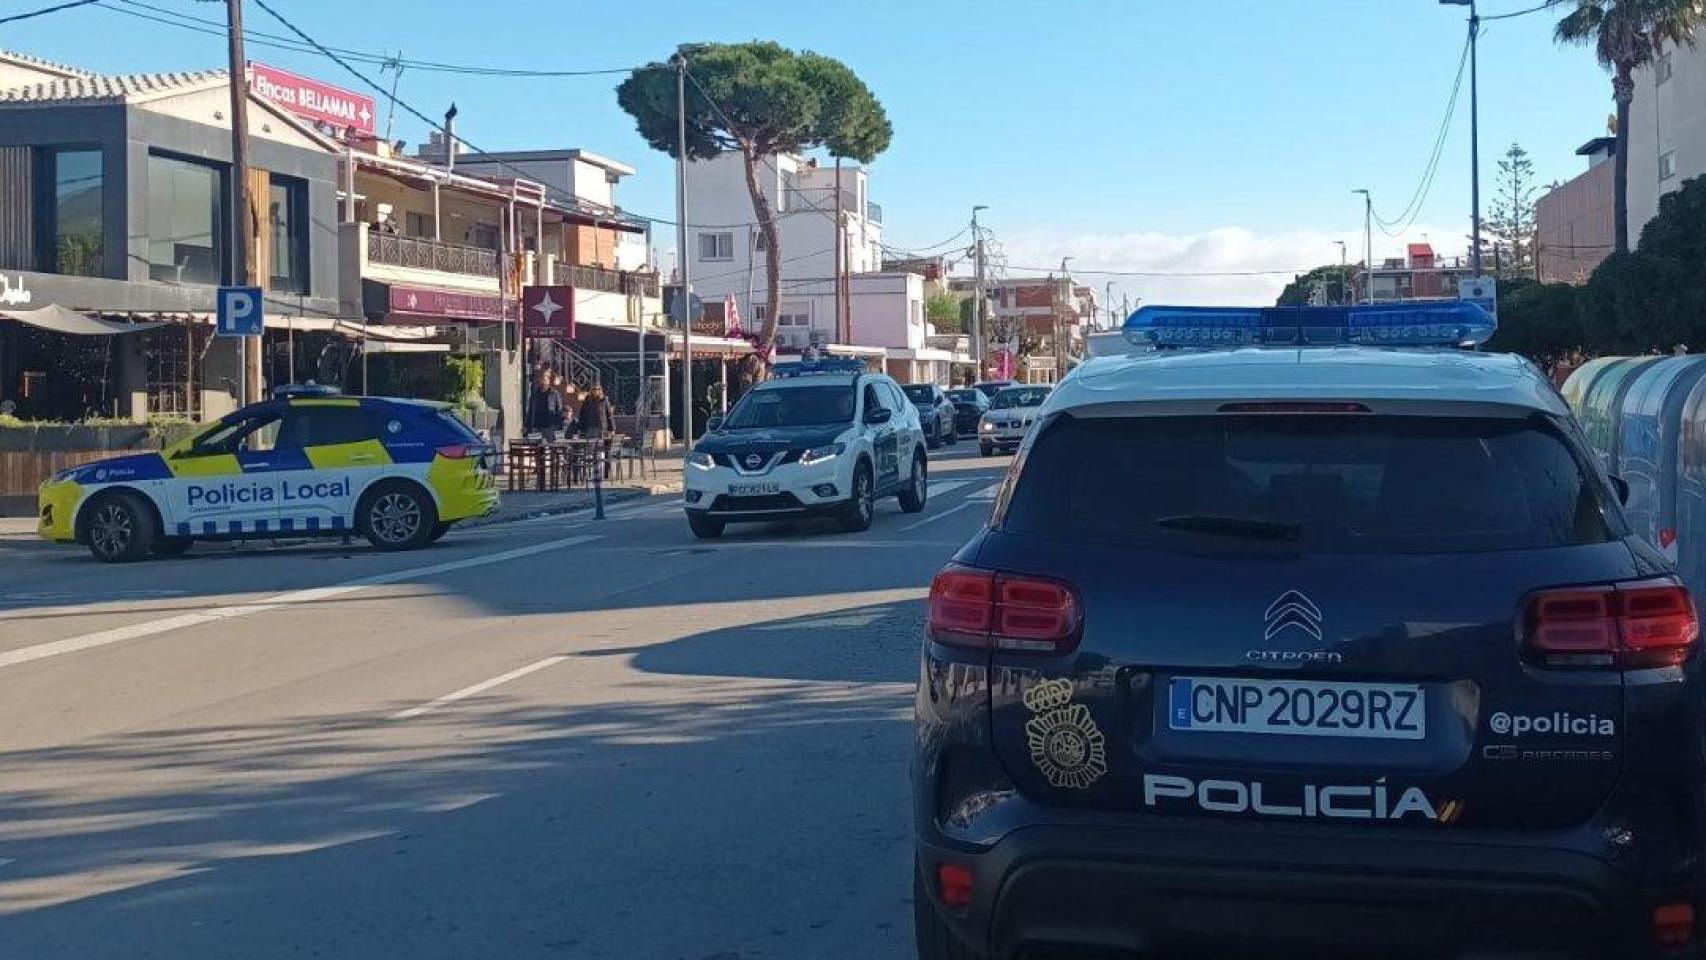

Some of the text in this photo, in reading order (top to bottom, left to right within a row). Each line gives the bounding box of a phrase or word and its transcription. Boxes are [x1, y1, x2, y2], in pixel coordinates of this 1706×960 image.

[256, 75, 356, 121] Fincas BELLAMAR
[225, 292, 254, 330] P
[187, 475, 351, 506] Policia Local
[1489, 711, 1616, 737] @policia
[1143, 773, 1438, 819] POLICÍA
